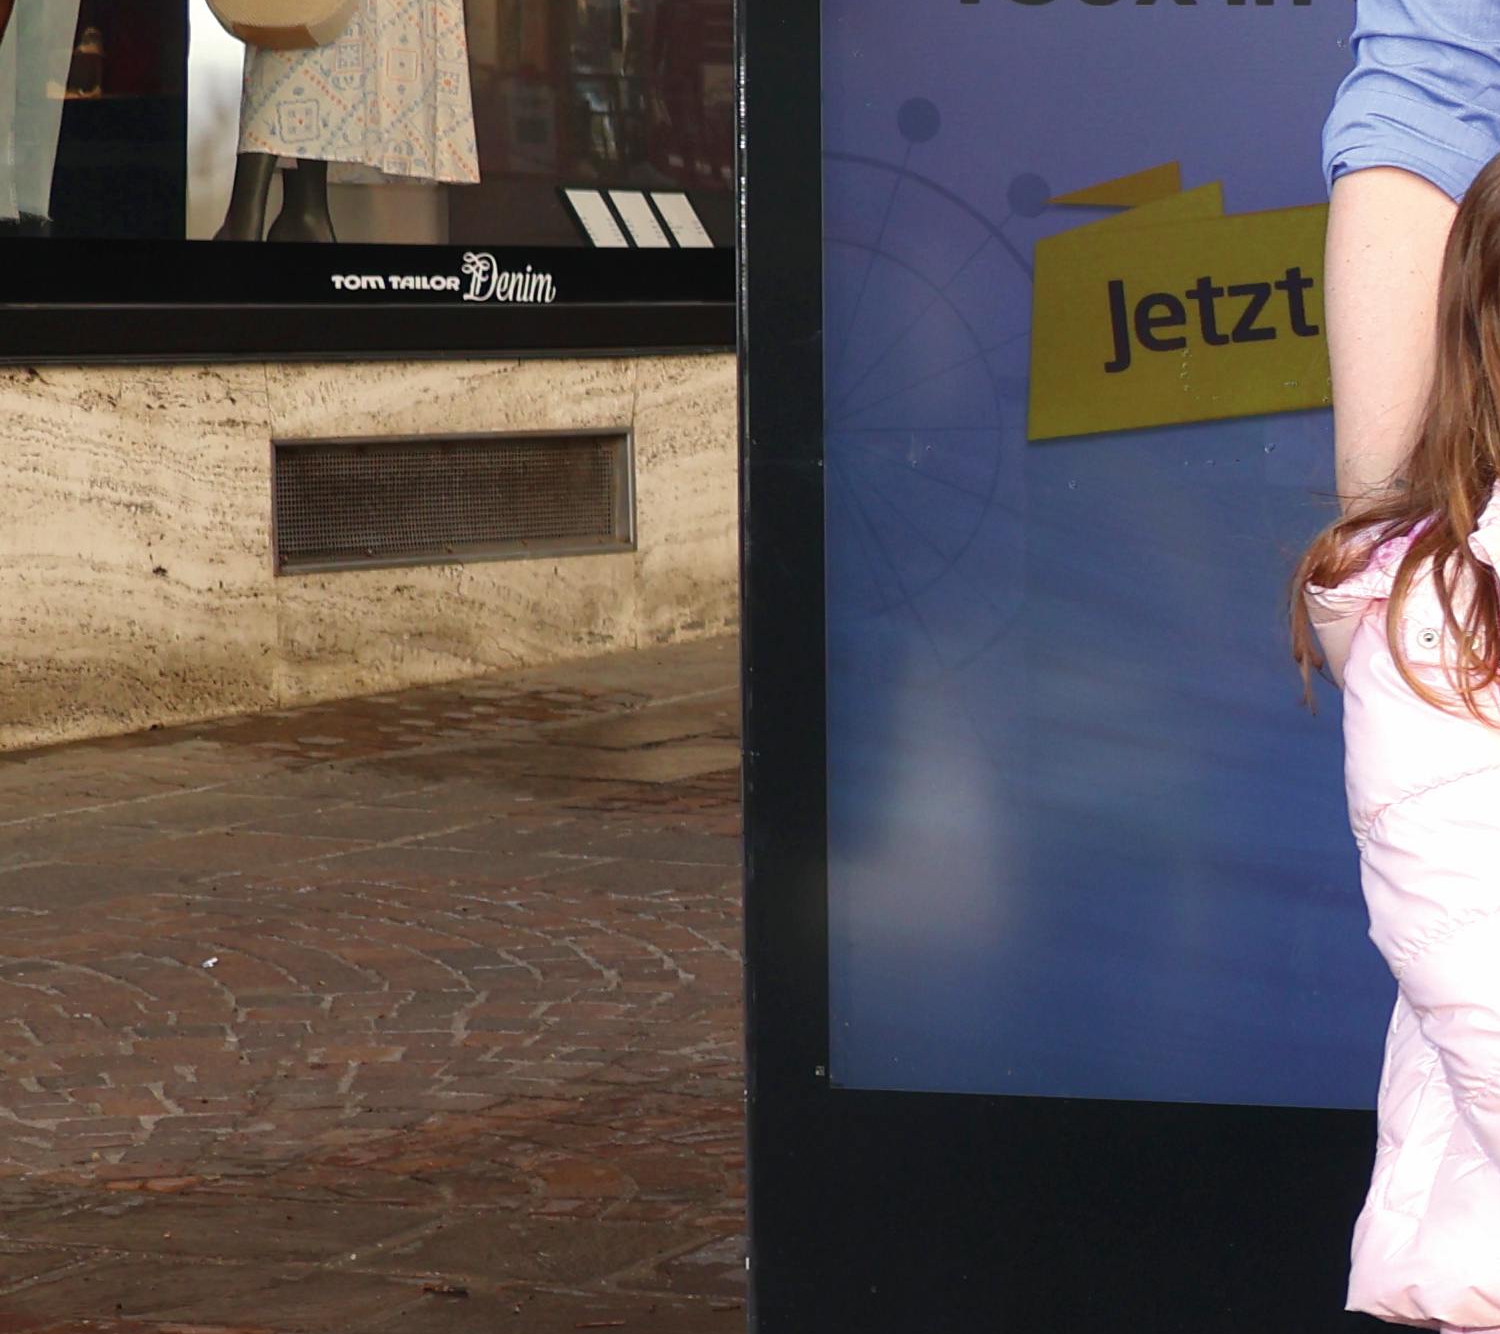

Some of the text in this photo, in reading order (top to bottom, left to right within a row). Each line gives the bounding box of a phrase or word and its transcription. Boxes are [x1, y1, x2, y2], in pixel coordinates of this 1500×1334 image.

[331, 252, 556, 303] TOM TAILOR Denim
[1104, 267, 1319, 373] Jetzt
